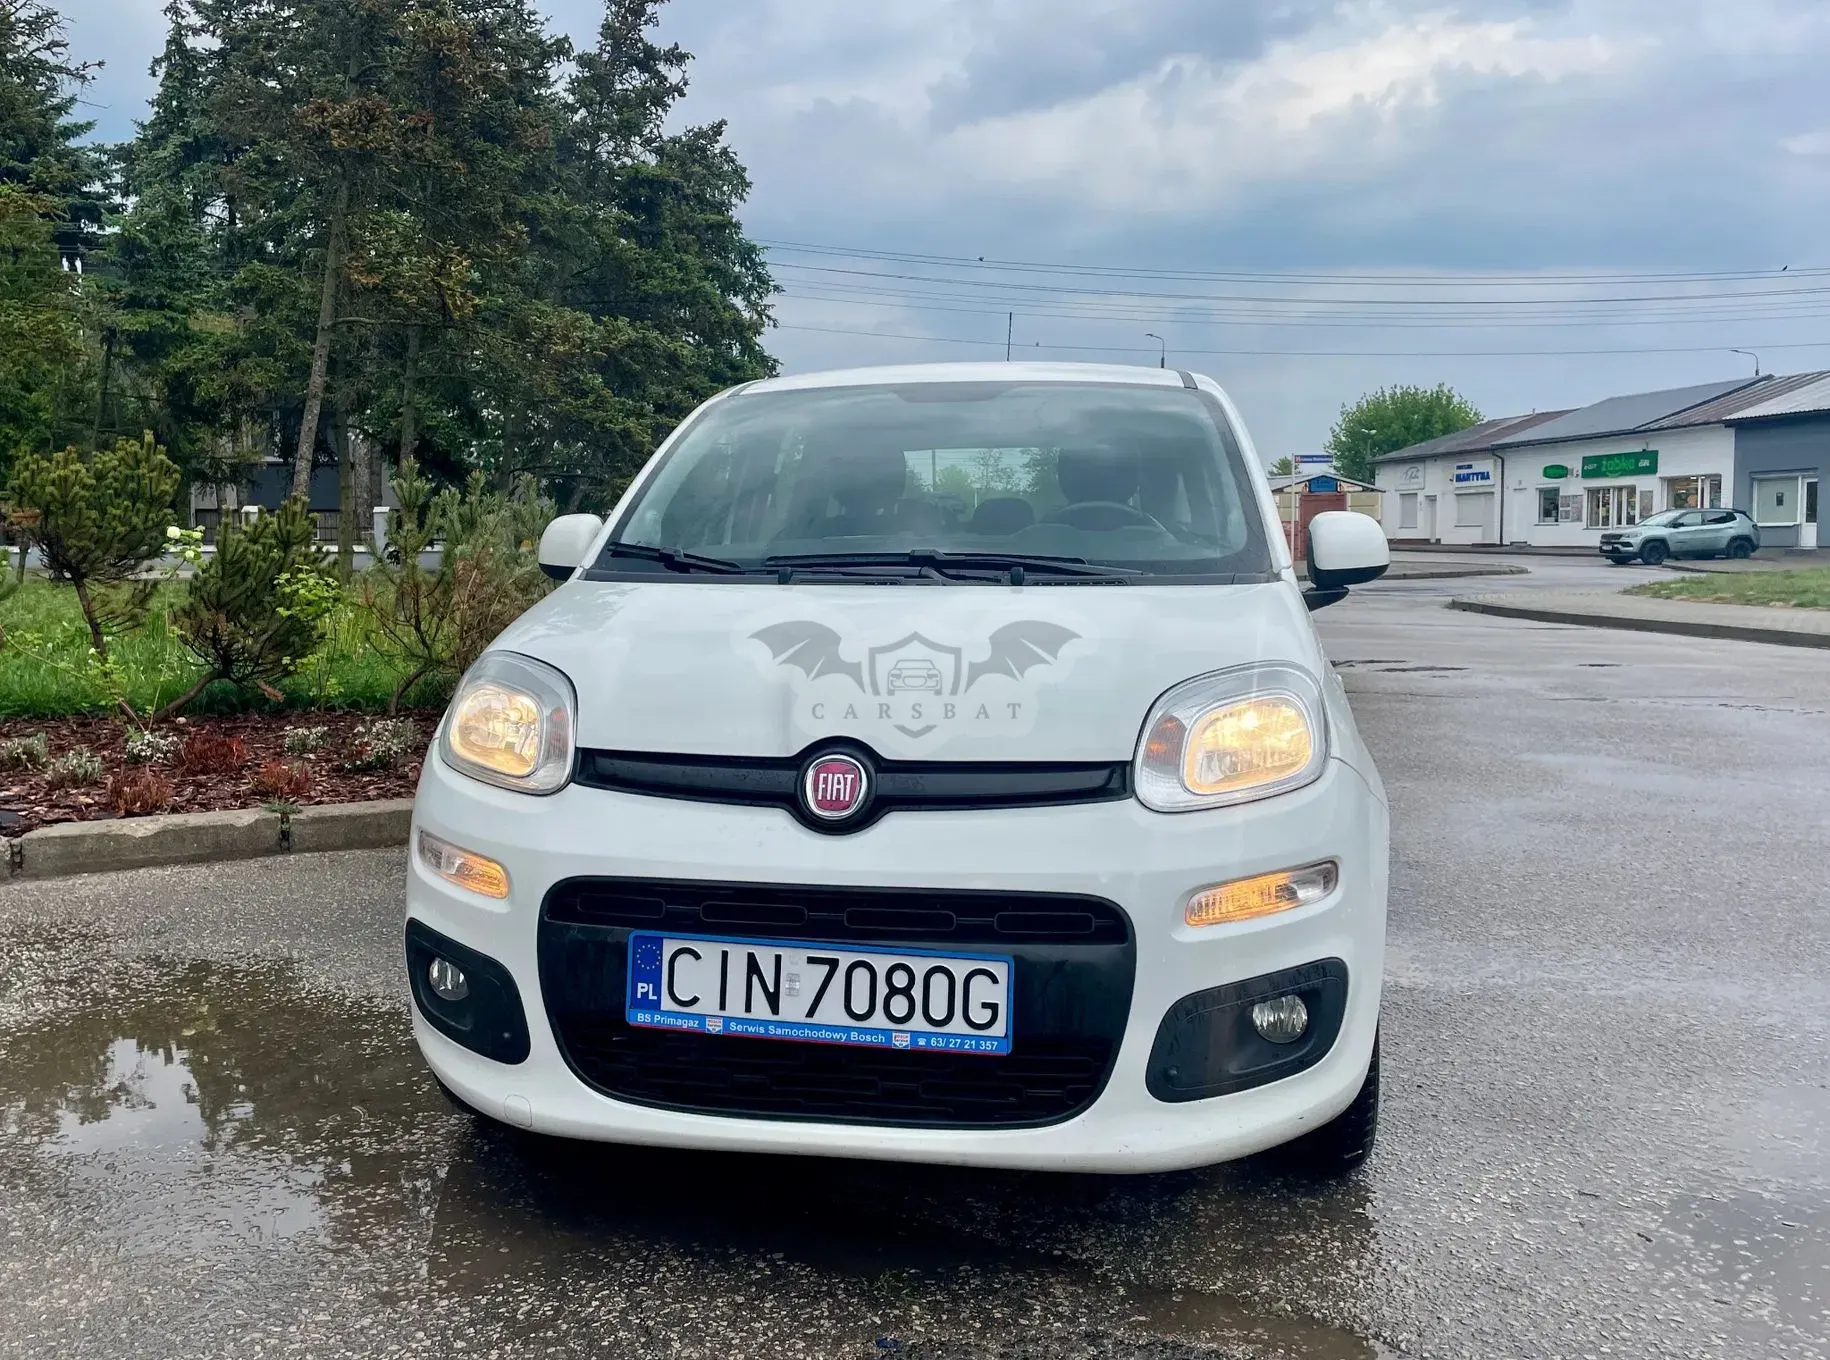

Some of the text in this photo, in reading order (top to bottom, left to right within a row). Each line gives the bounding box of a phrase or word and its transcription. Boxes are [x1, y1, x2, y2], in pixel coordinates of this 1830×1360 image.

[817, 772, 855, 801] FIAT
[636, 982, 658, 1000] PL
[666, 946, 1000, 1031] CIN 7080G
[637, 1012, 699, 1029] BS Primagaz
[729, 1021, 885, 1043] Serwis Samochodowy Bosch
[930, 1037, 998, 1051] 63/ 27 21 357
